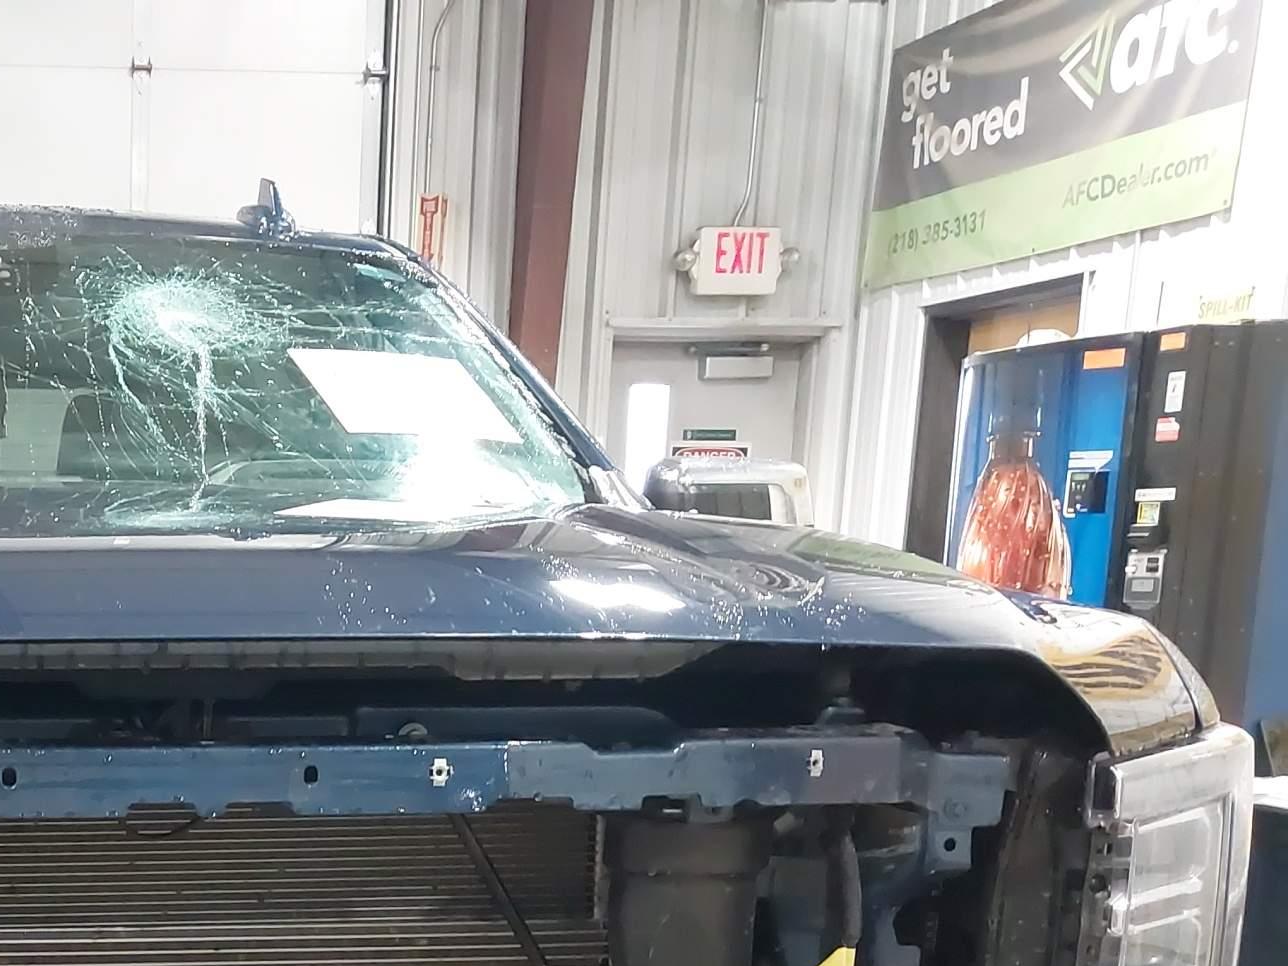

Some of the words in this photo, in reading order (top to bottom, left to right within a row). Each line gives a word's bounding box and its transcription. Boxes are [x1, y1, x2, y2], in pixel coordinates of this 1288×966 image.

[901, 48, 954, 123] get
[912, 76, 1030, 169] floored
[1062, 153, 1210, 209] AFCDealer.com
[715, 232, 770, 274] EXIT
[887, 228, 919, 258] (218)
[922, 208, 986, 245] 385-3131
